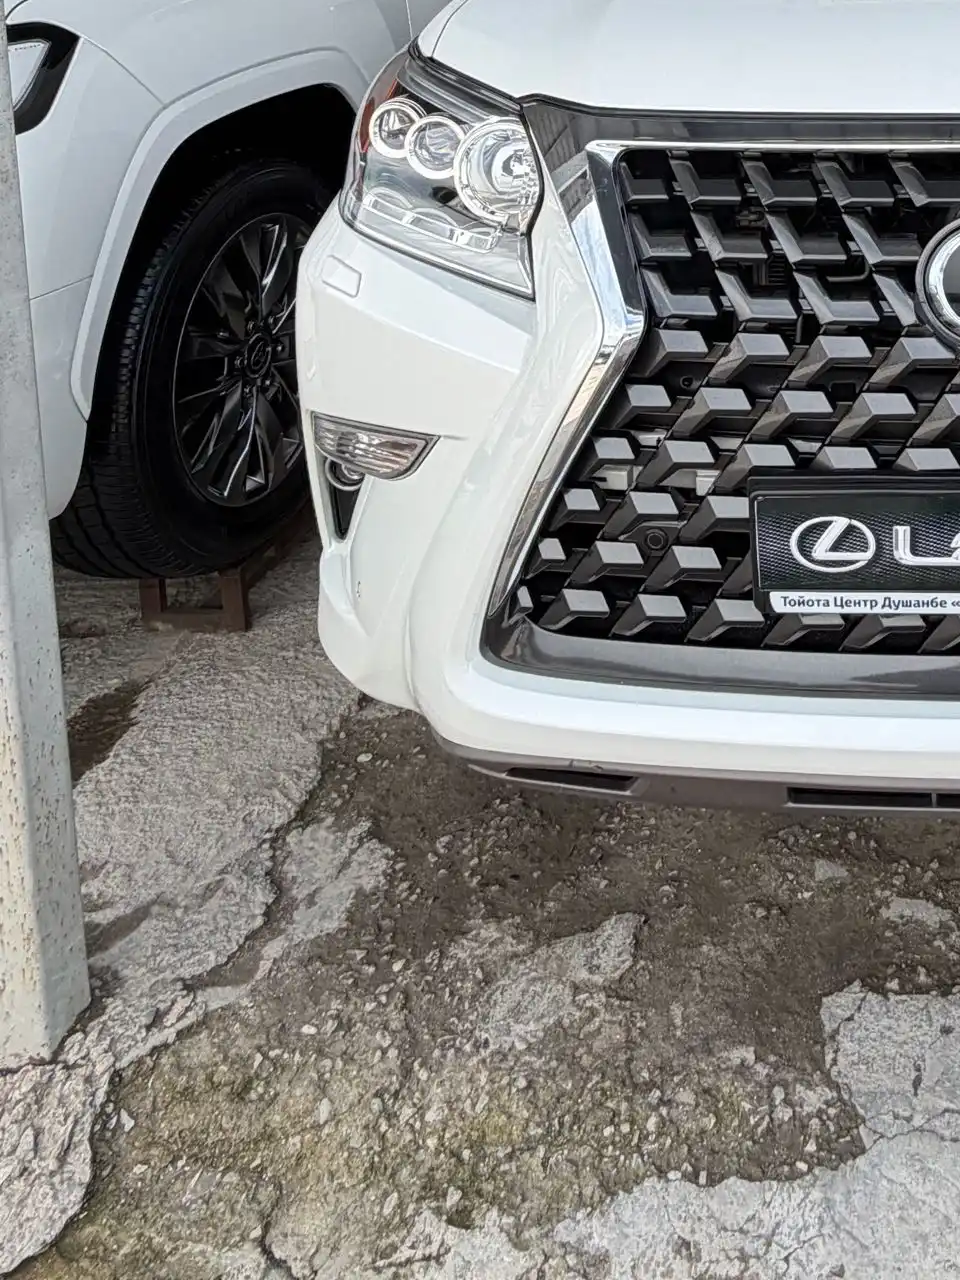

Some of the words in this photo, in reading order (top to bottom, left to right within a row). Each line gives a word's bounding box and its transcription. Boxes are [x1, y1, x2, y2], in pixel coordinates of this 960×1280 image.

[780, 595, 831, 608] Тойота
[833, 596, 879, 610] Центр
[880, 595, 948, 611] Душанбе
